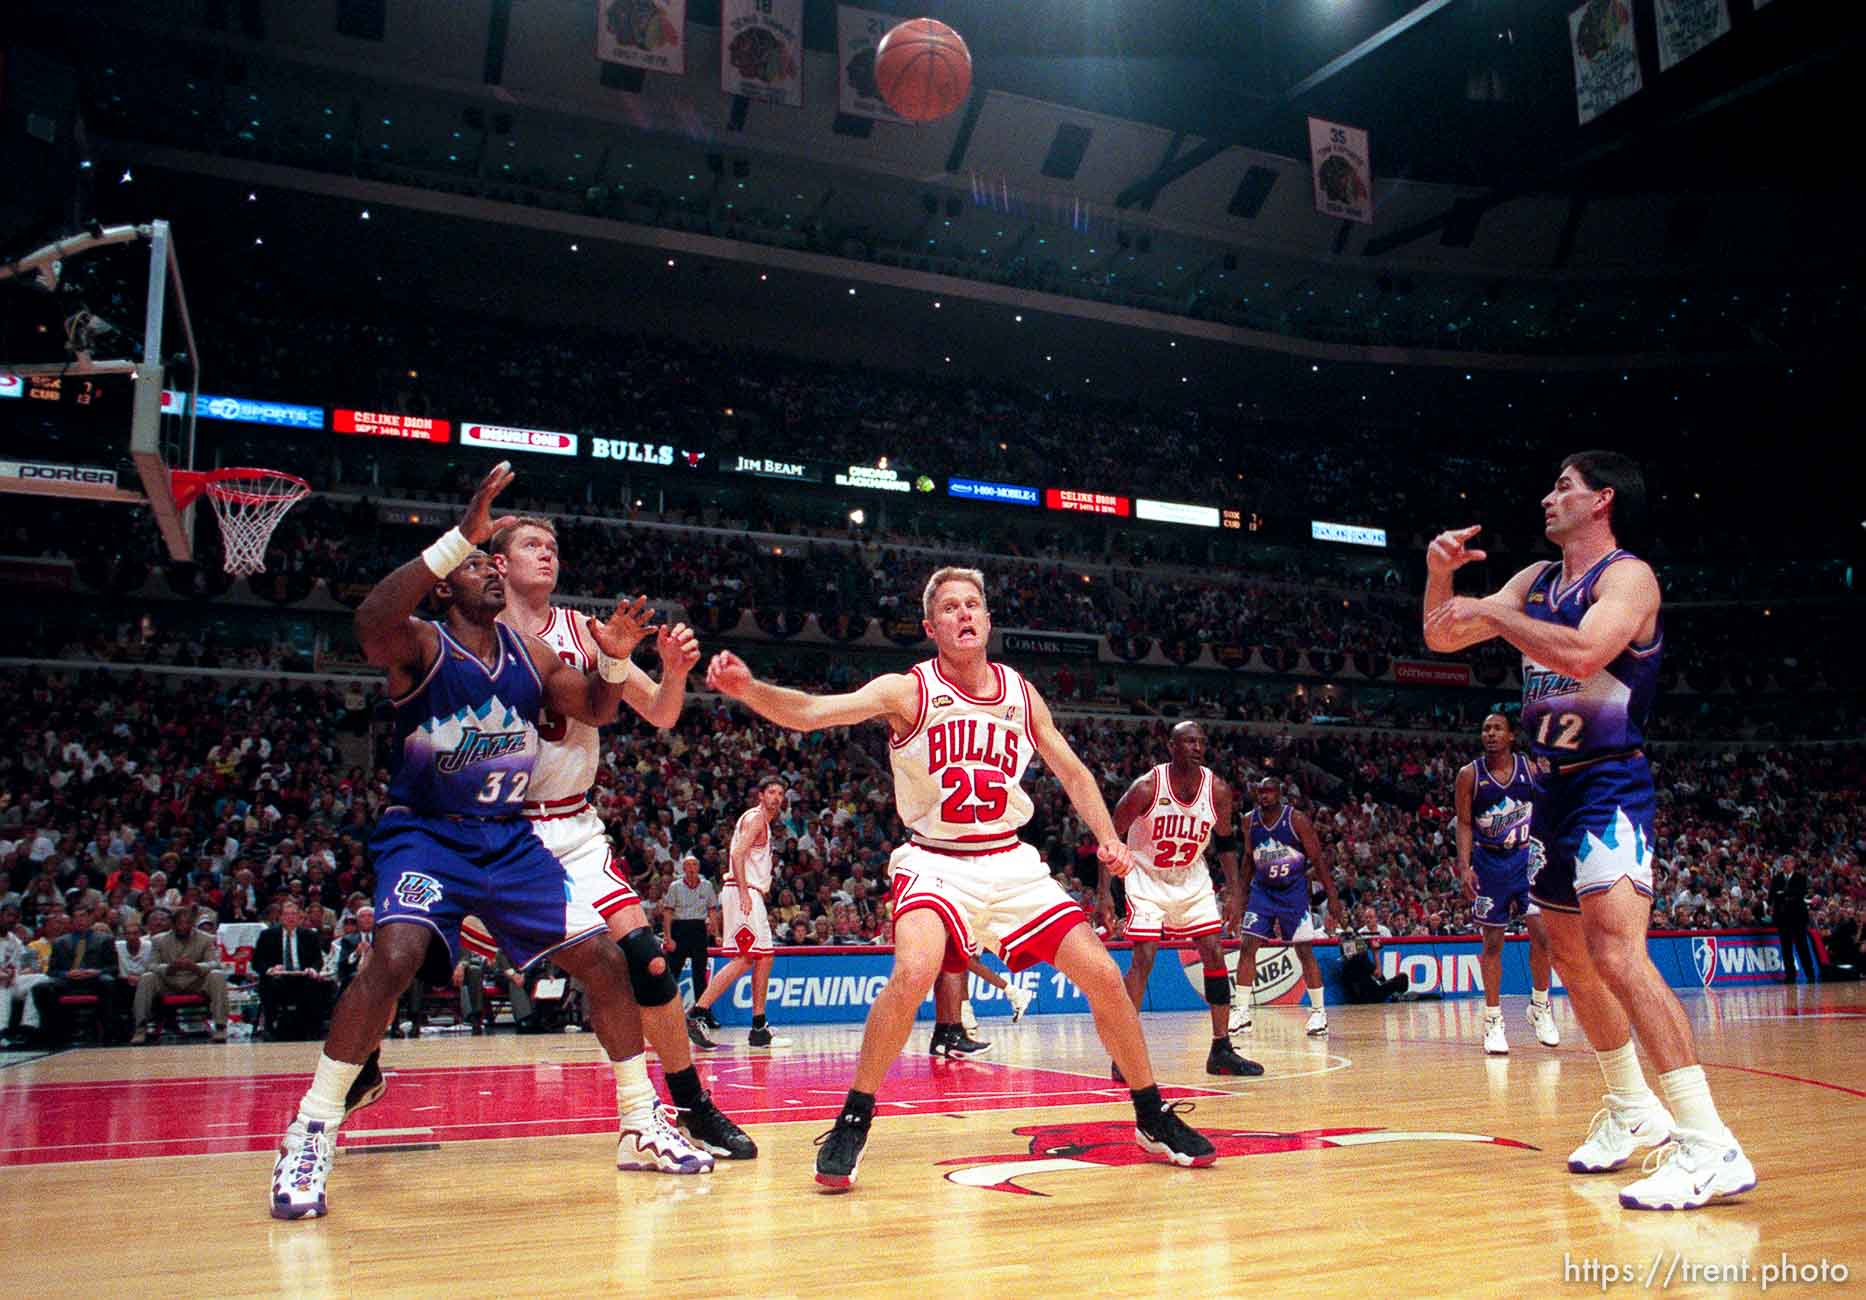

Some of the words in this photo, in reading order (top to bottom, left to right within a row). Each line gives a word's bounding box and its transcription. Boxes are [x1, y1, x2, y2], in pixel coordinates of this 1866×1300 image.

[1329, 128, 1346, 144] 35
[354, 411, 401, 426] CELINE
[404, 416, 433, 429] DION
[592, 437, 675, 466] BULLS
[19, 464, 115, 485] porter
[735, 456, 762, 472] JIM
[764, 459, 804, 476] BEAM
[849, 466, 898, 481] CHICAGO
[836, 474, 911, 492] BLACKHAWKS
[1060, 490, 1093, 503] CELINE
[1536, 712, 1585, 751] 12
[928, 720, 1018, 778] BULLS
[477, 771, 530, 803] 32
[941, 766, 1008, 824] 25
[1151, 814, 1210, 843] BULLS
[1153, 840, 1199, 869] 23
[1269, 863, 1291, 879] 55
[1718, 946, 1799, 974] WNB
[733, 975, 889, 1009] OPENING
